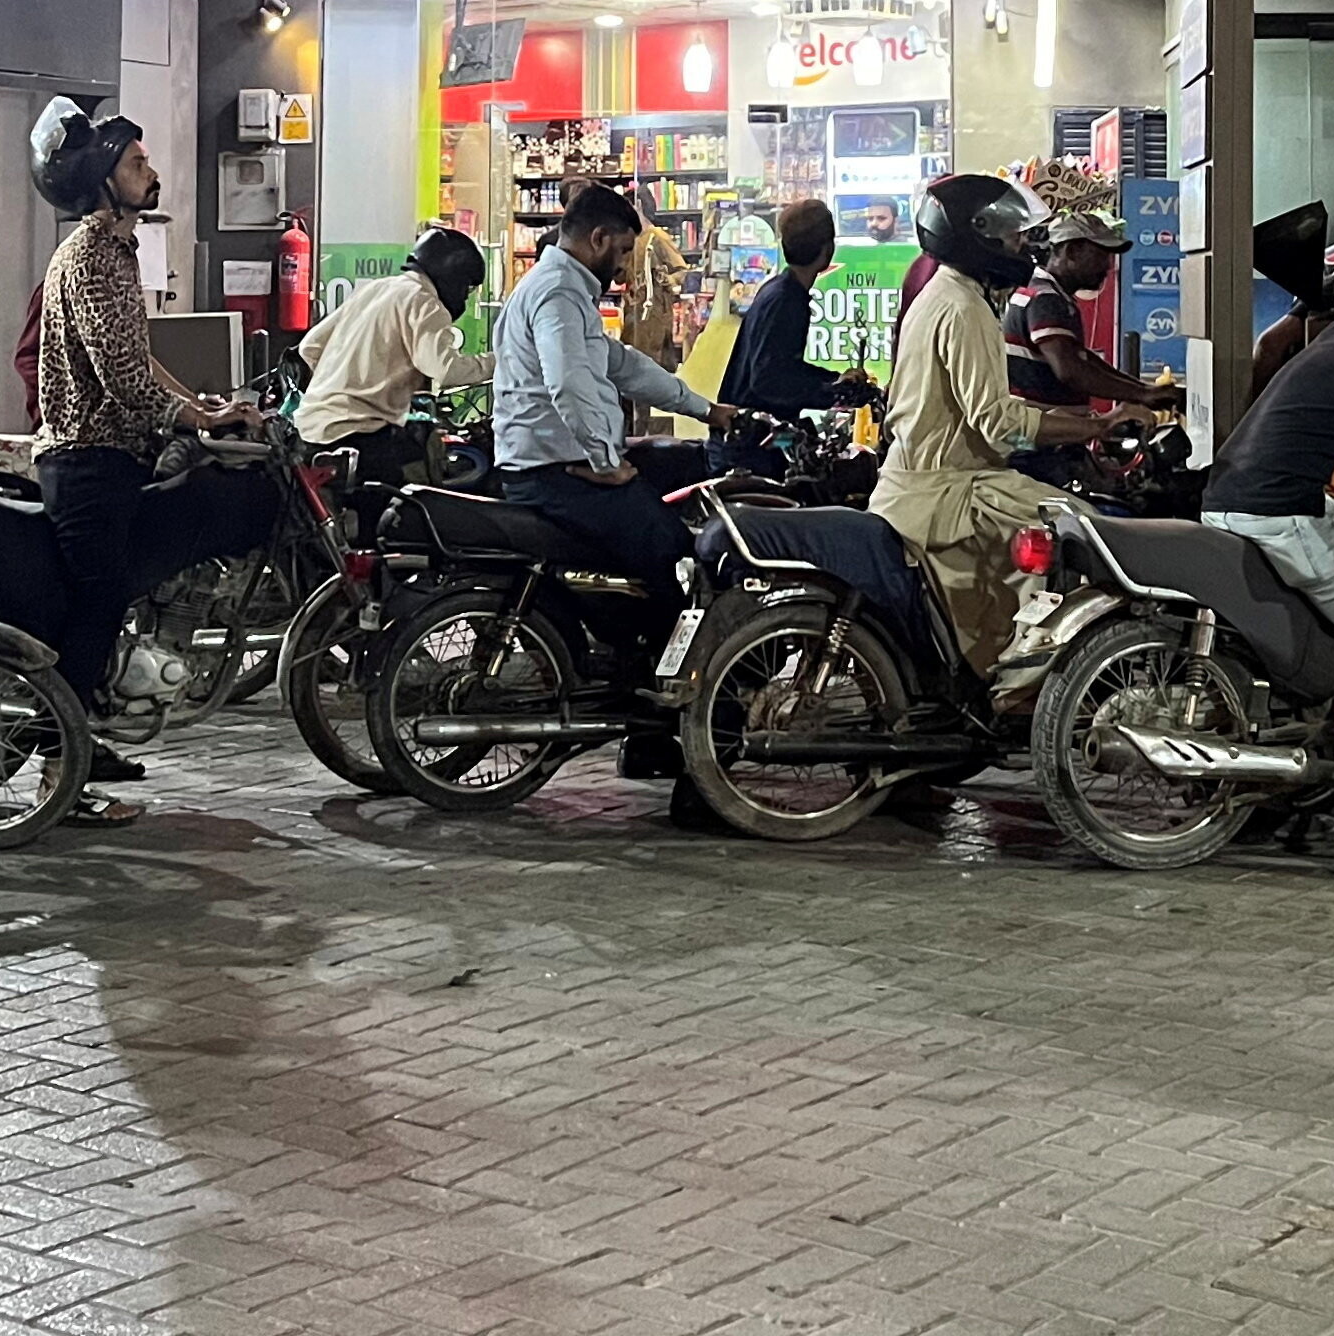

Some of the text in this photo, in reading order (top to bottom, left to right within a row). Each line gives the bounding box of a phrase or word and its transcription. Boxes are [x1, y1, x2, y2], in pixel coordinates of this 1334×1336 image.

[1139, 196, 1180, 215] ZY
[355, 258, 393, 275] NOW
[846, 273, 876, 286] NOW
[808, 288, 903, 323] SOFTE
[855, 309, 867, 328] &
